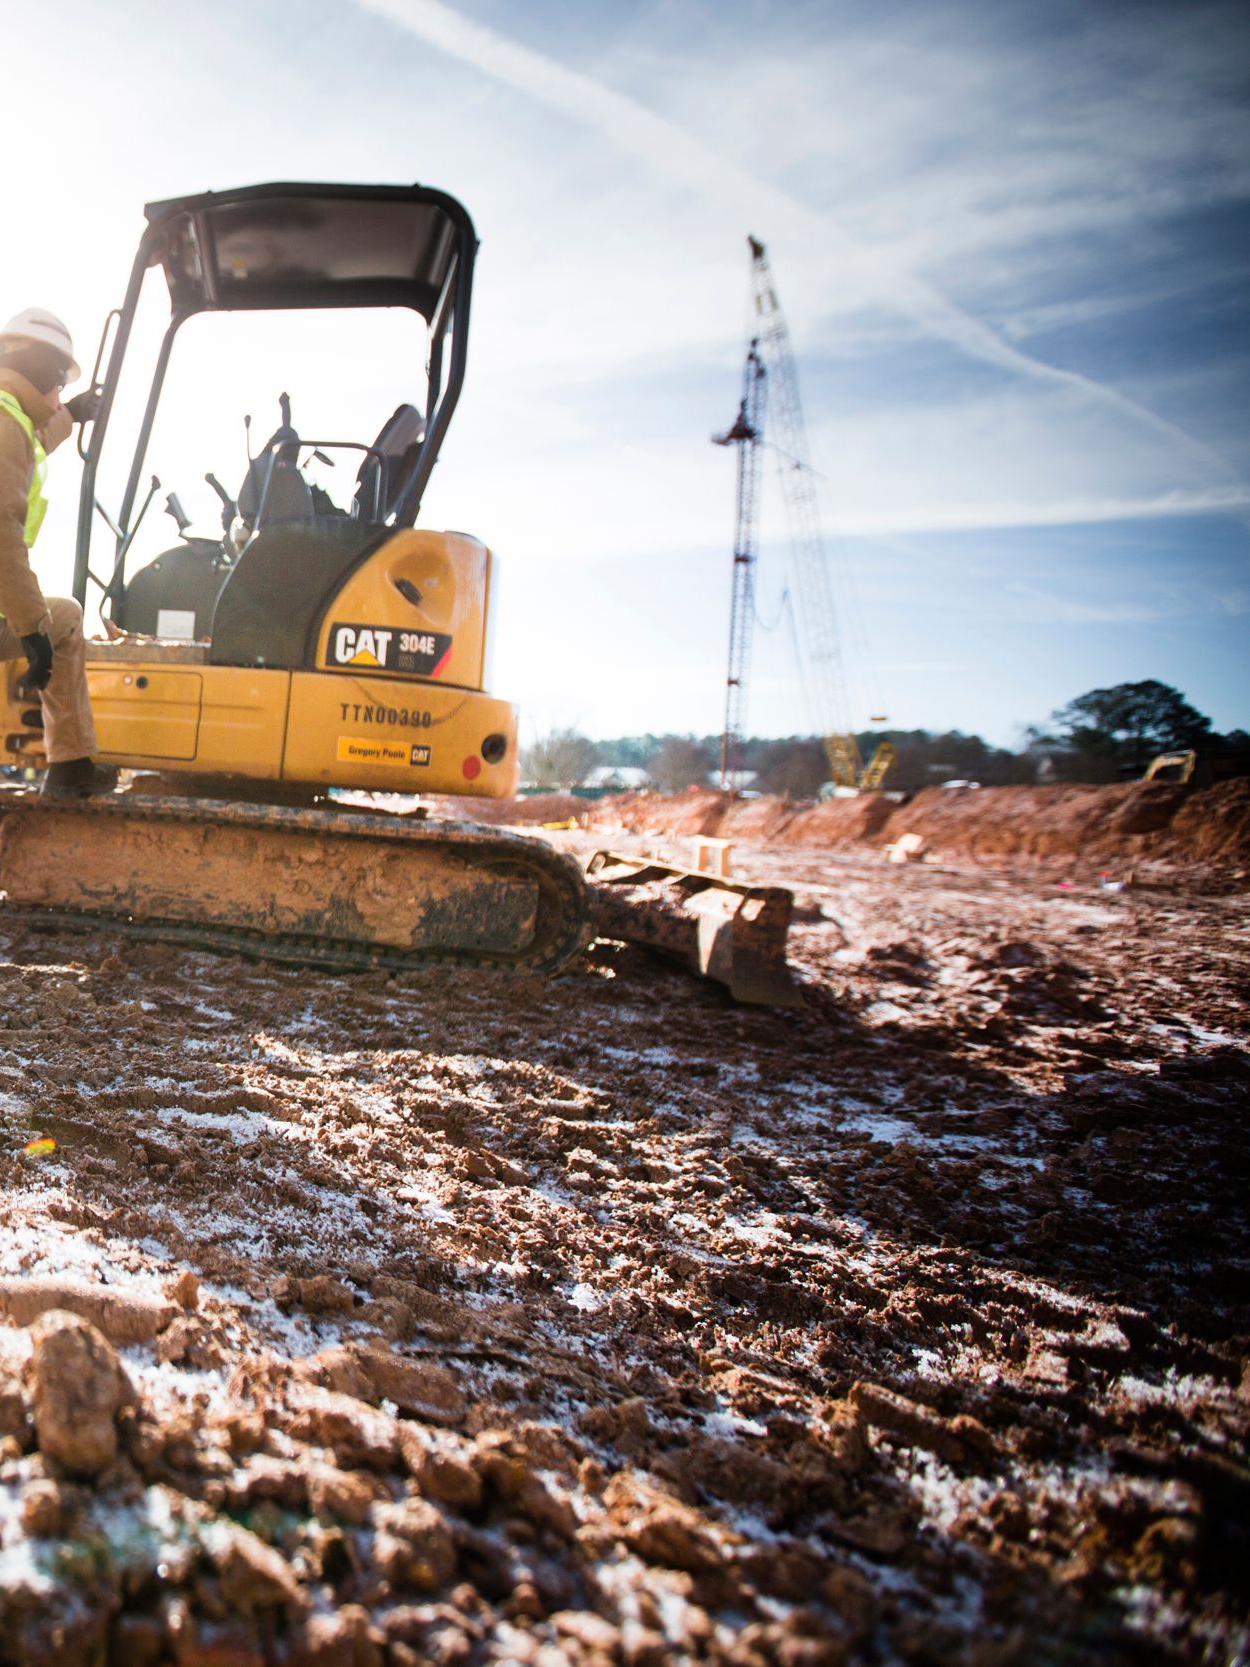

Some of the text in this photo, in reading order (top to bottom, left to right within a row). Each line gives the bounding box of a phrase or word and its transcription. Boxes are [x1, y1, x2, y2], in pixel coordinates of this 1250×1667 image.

[335, 627, 392, 667] CAT
[399, 633, 436, 656] 304E
[412, 749, 429, 762] CAT
